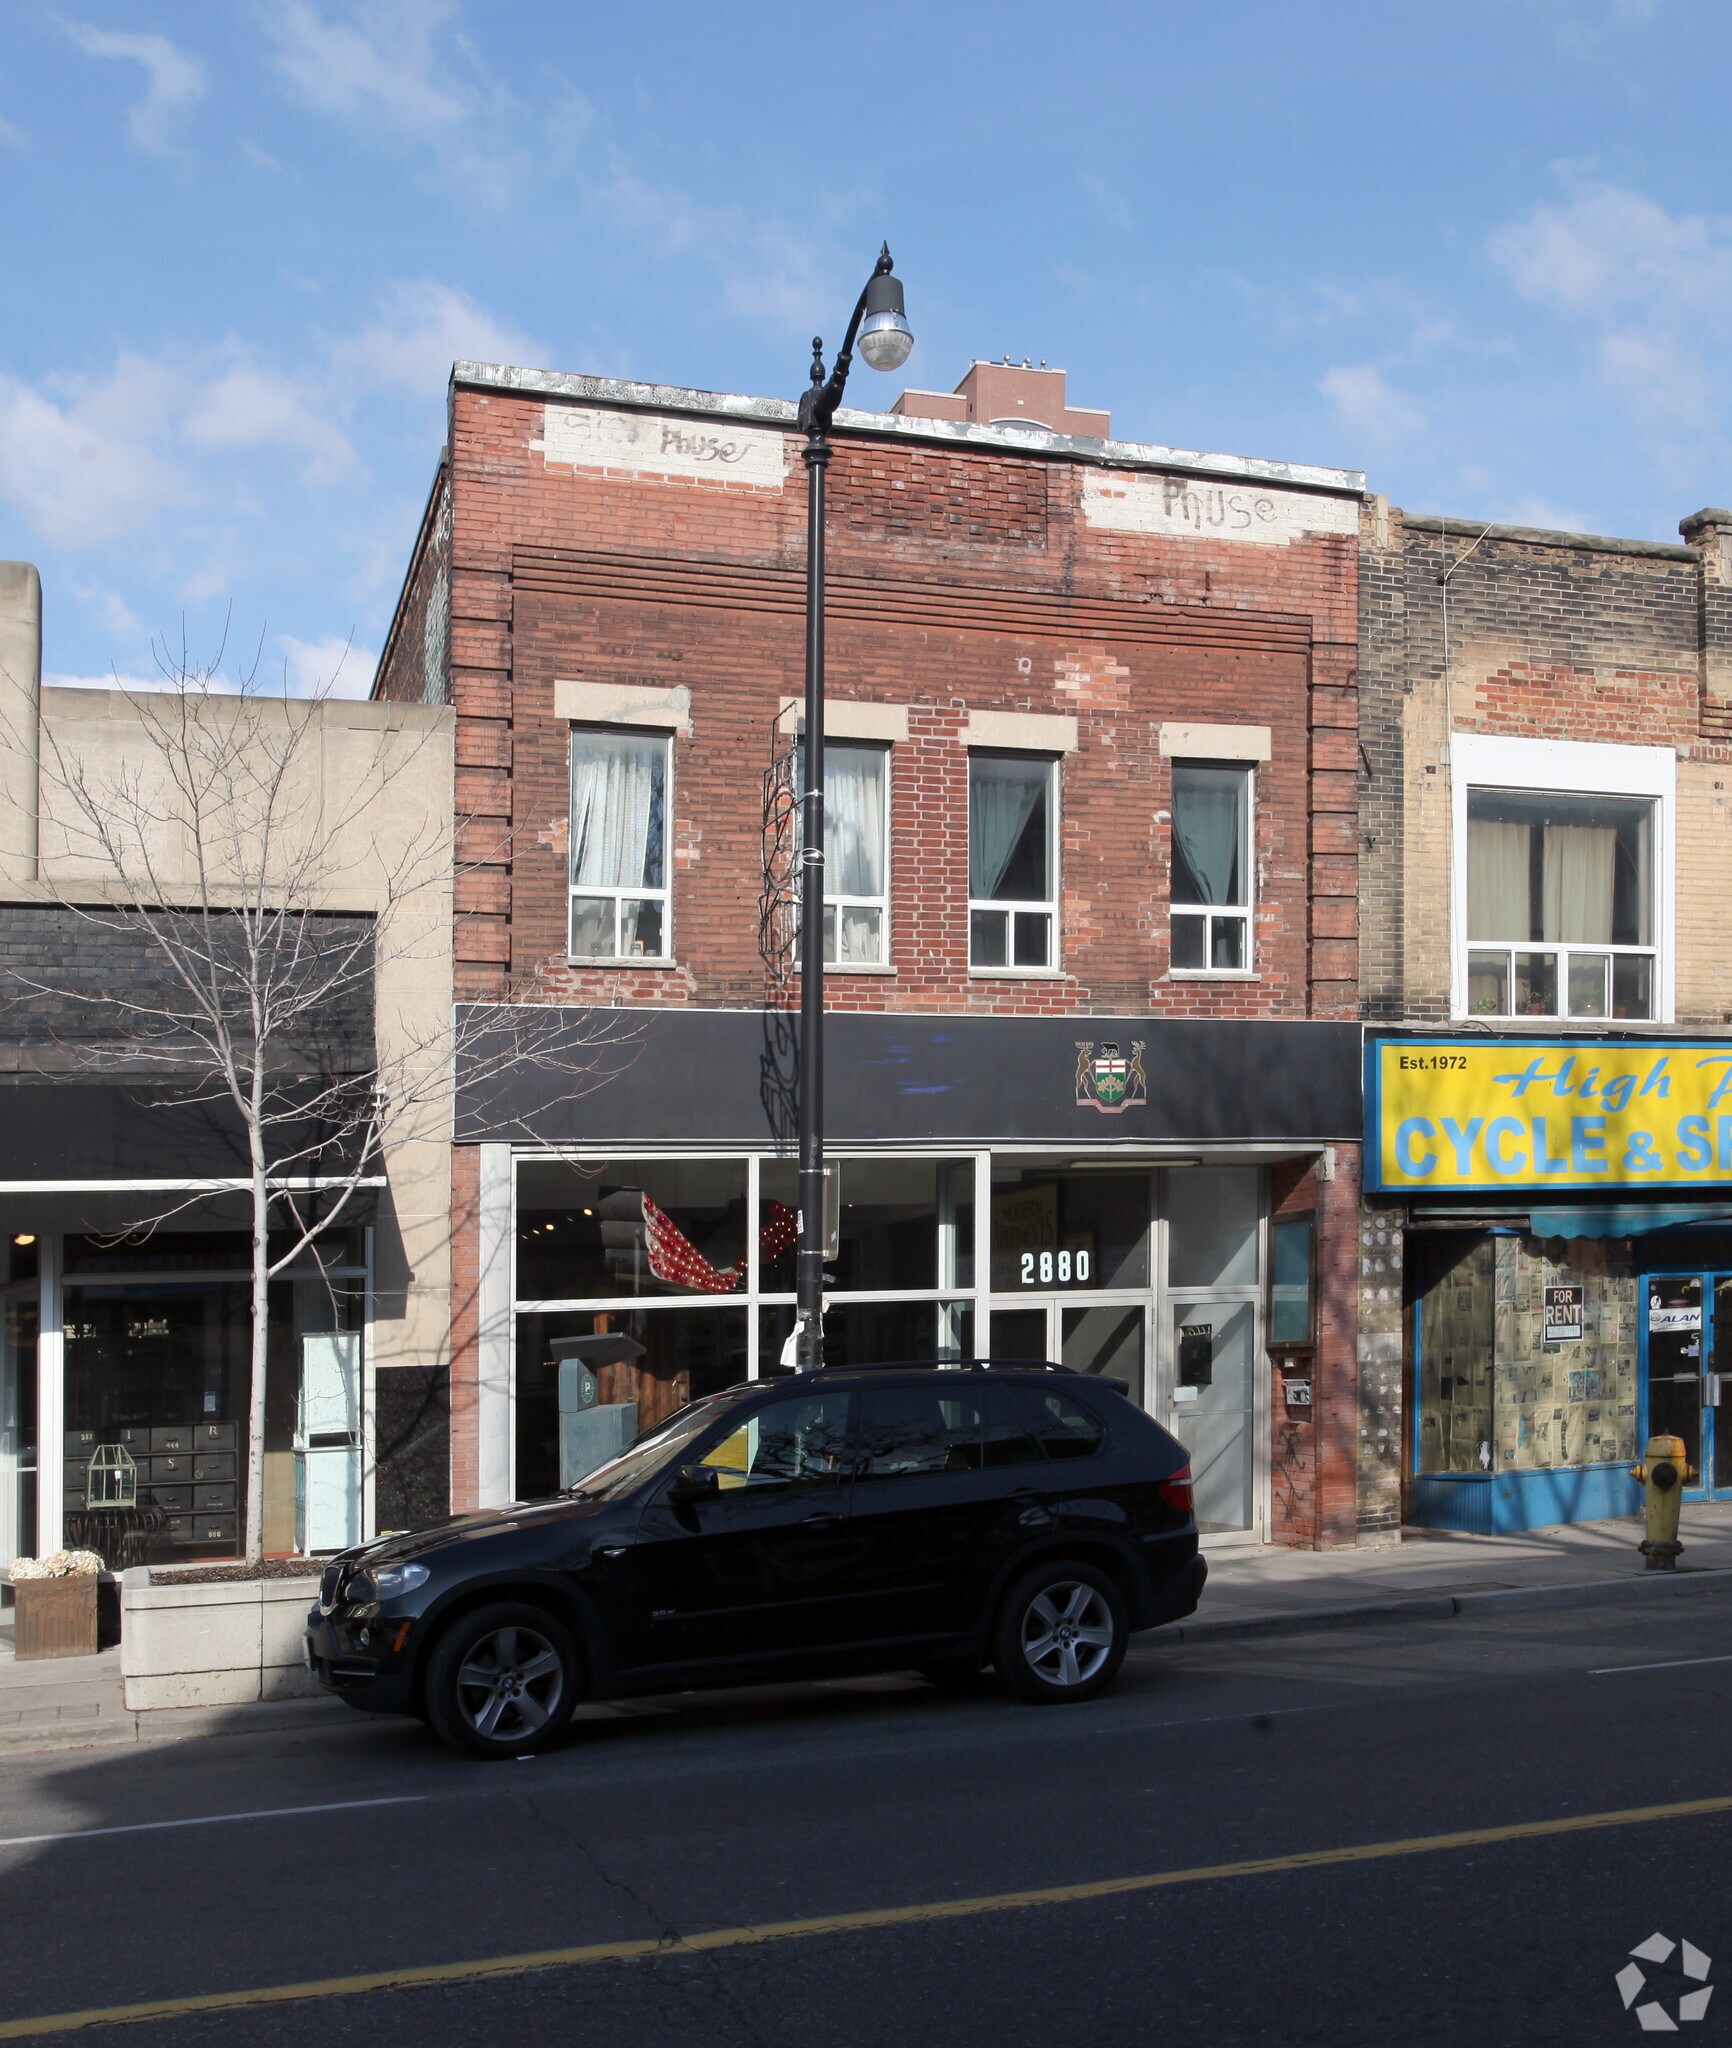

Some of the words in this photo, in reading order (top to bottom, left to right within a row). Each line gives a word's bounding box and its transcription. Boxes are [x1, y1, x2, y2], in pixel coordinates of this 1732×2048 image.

[1399, 1055, 1467, 1070] Est.1972
[1492, 1055, 1671, 1112] High
[1394, 1116, 1609, 1177] CYCLE
[1622, 1131, 1664, 1171] &
[1021, 1250, 1090, 1284] 2880
[1553, 1290, 1573, 1303] FOR
[1545, 1304, 1582, 1325] RENT
[1660, 1313, 1700, 1323] ALAN
[209, 1425, 218, 1435] R
[168, 1458, 175, 1467] S
